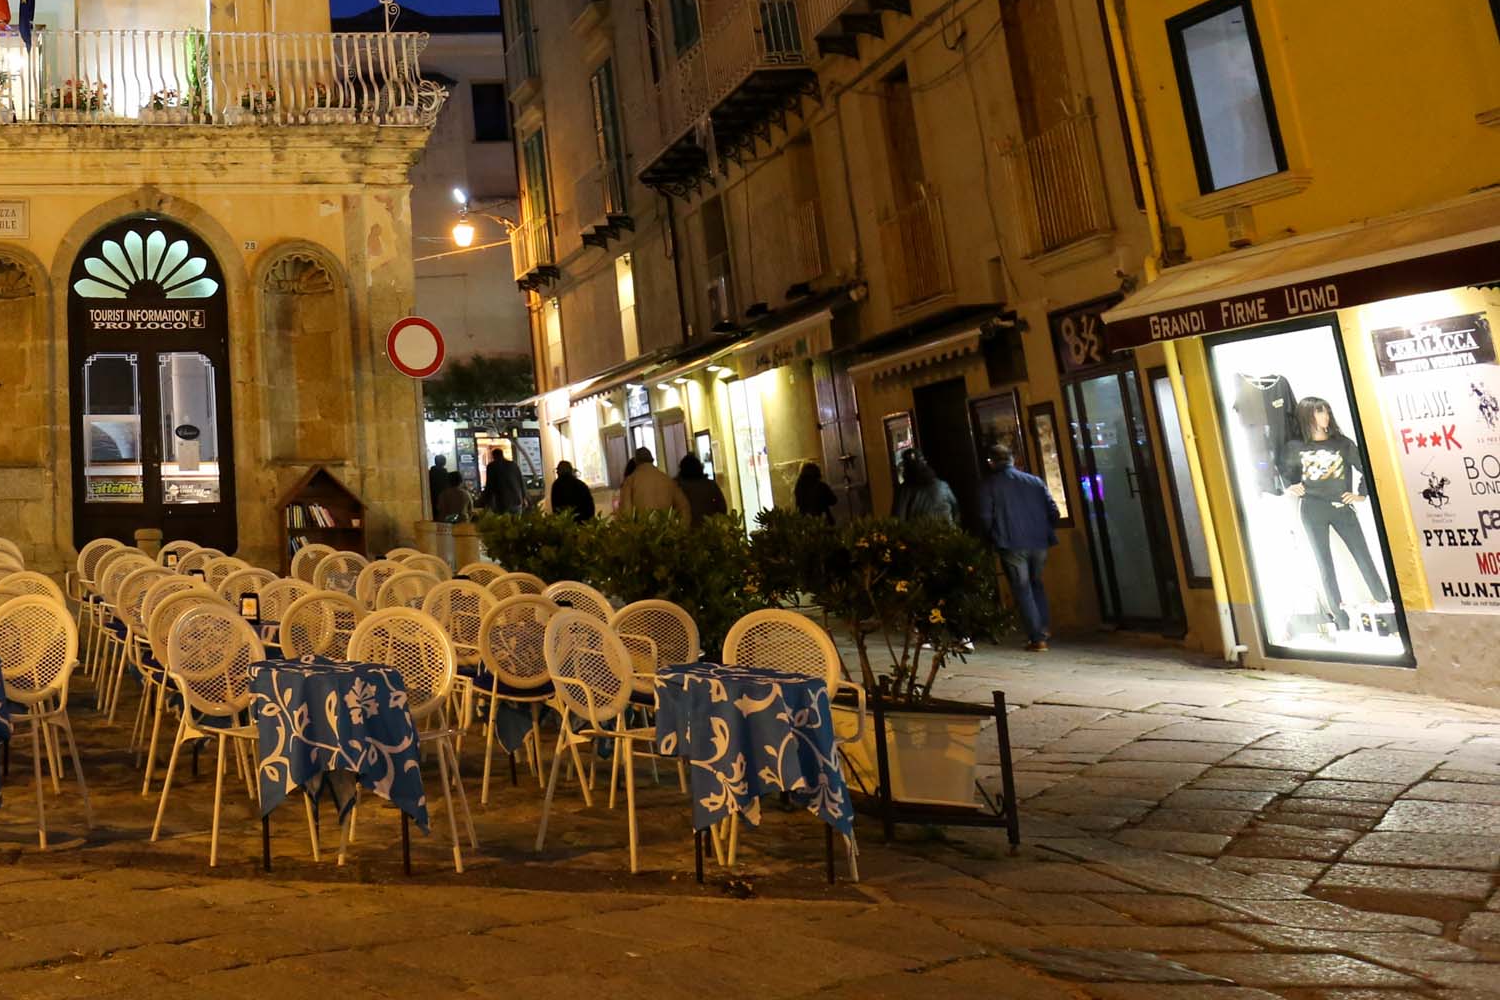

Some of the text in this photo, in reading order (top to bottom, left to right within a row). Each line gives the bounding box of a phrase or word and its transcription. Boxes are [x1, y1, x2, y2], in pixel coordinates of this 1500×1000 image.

[89, 309, 125, 322] TOURIST
[127, 309, 189, 322] INFORMATION
[1149, 284, 1340, 340] GRANDI FIRME UOMO
[93, 321, 187, 330] PRO LOCO
[1423, 528, 1483, 547] PYREX
